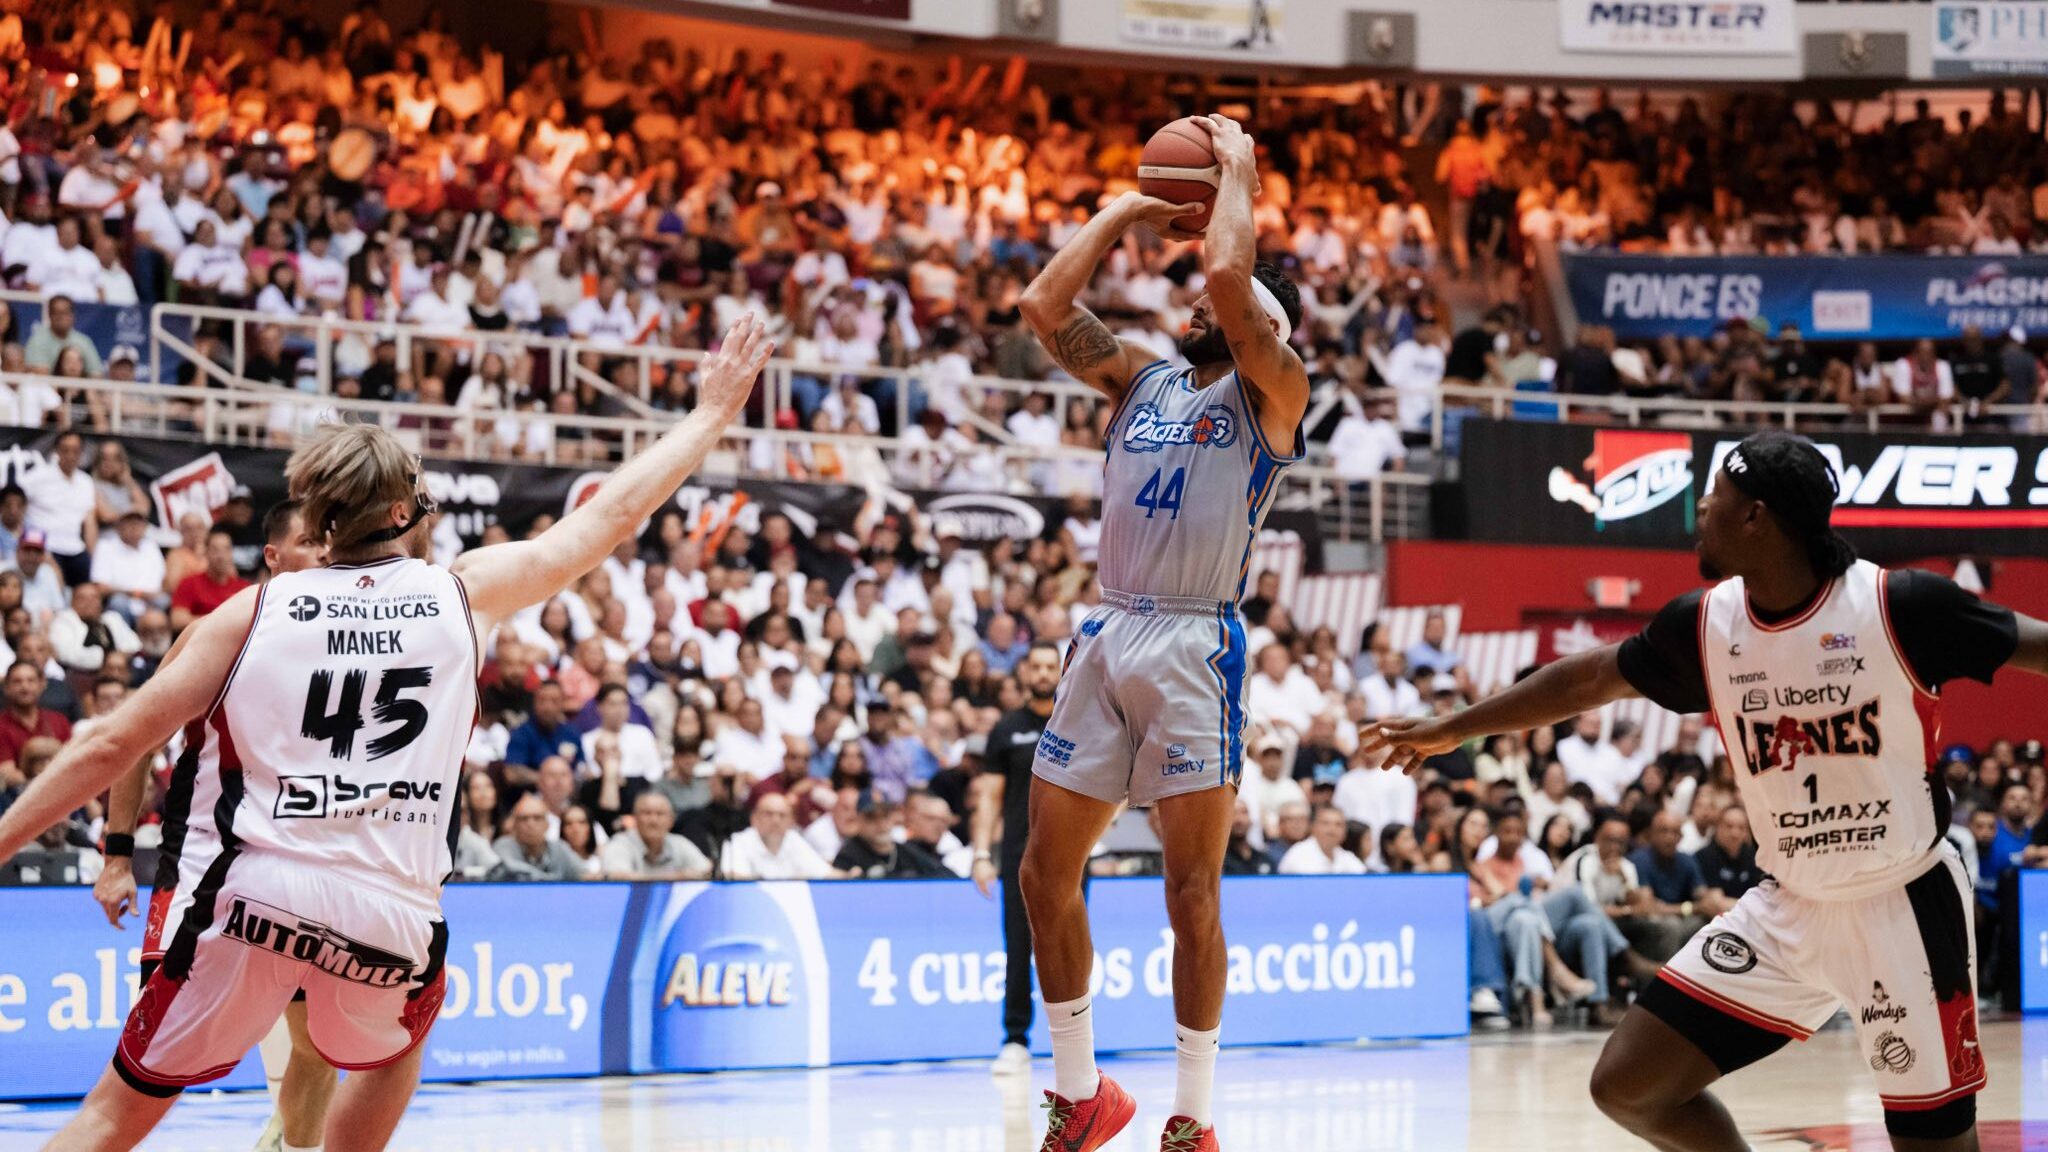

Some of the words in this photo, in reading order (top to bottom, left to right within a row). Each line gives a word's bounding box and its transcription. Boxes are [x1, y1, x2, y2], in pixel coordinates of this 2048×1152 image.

[1590, 3, 1764, 27] MASTER
[1602, 272, 1717, 319] PONCE
[1716, 274, 1763, 320] ES
[1135, 467, 1184, 519] 44
[326, 595, 358, 603] CENTRO
[327, 603, 367, 619] SAN
[374, 602, 439, 620] LUCAS
[328, 630, 403, 655] MANEK
[1774, 683, 1851, 708] Liberty
[300, 666, 433, 762] 45
[1043, 730, 1076, 751] omas
[1733, 695, 1882, 776] LENES
[1039, 738, 1071, 761] erdes
[1161, 759, 1205, 776] Liberty
[1803, 773, 1818, 804] 1
[1771, 800, 1892, 828] COMAXX
[1795, 825, 1886, 850] MASTER
[1835, 844, 1877, 853] RENTAL
[857, 937, 898, 1006] 4
[1227, 919, 1415, 995] acción!
[438, 941, 588, 1031] olor,
[663, 953, 793, 1009] ALEVE
[1861, 1002, 1907, 1024] Wendy's
